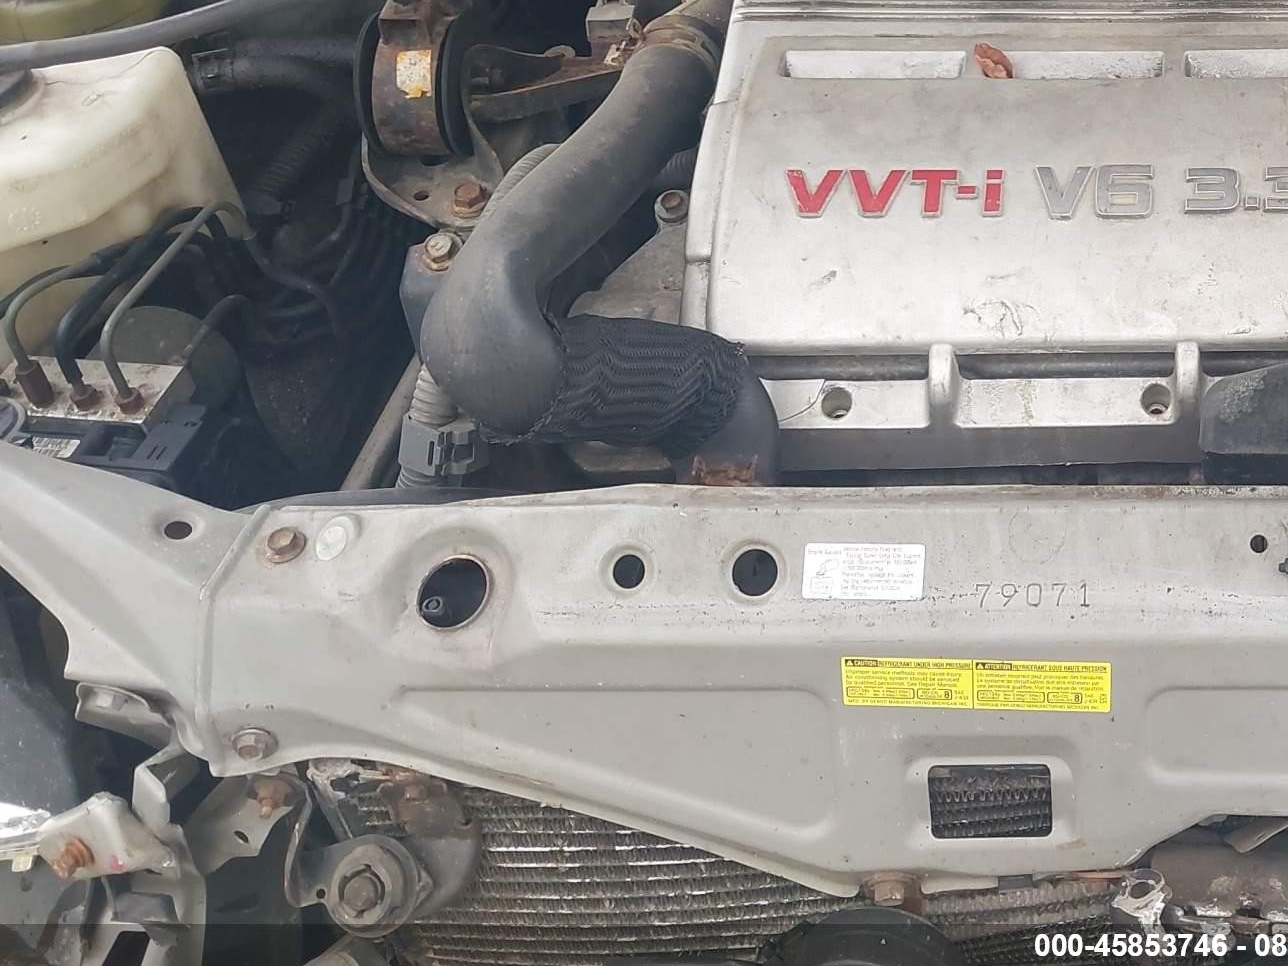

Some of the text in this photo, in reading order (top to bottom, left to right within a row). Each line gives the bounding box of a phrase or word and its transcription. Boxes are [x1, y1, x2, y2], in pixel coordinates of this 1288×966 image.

[785, 167, 1005, 218] VVT-i
[1035, 164, 1154, 219] V6
[975, 582, 1090, 609] 79071
